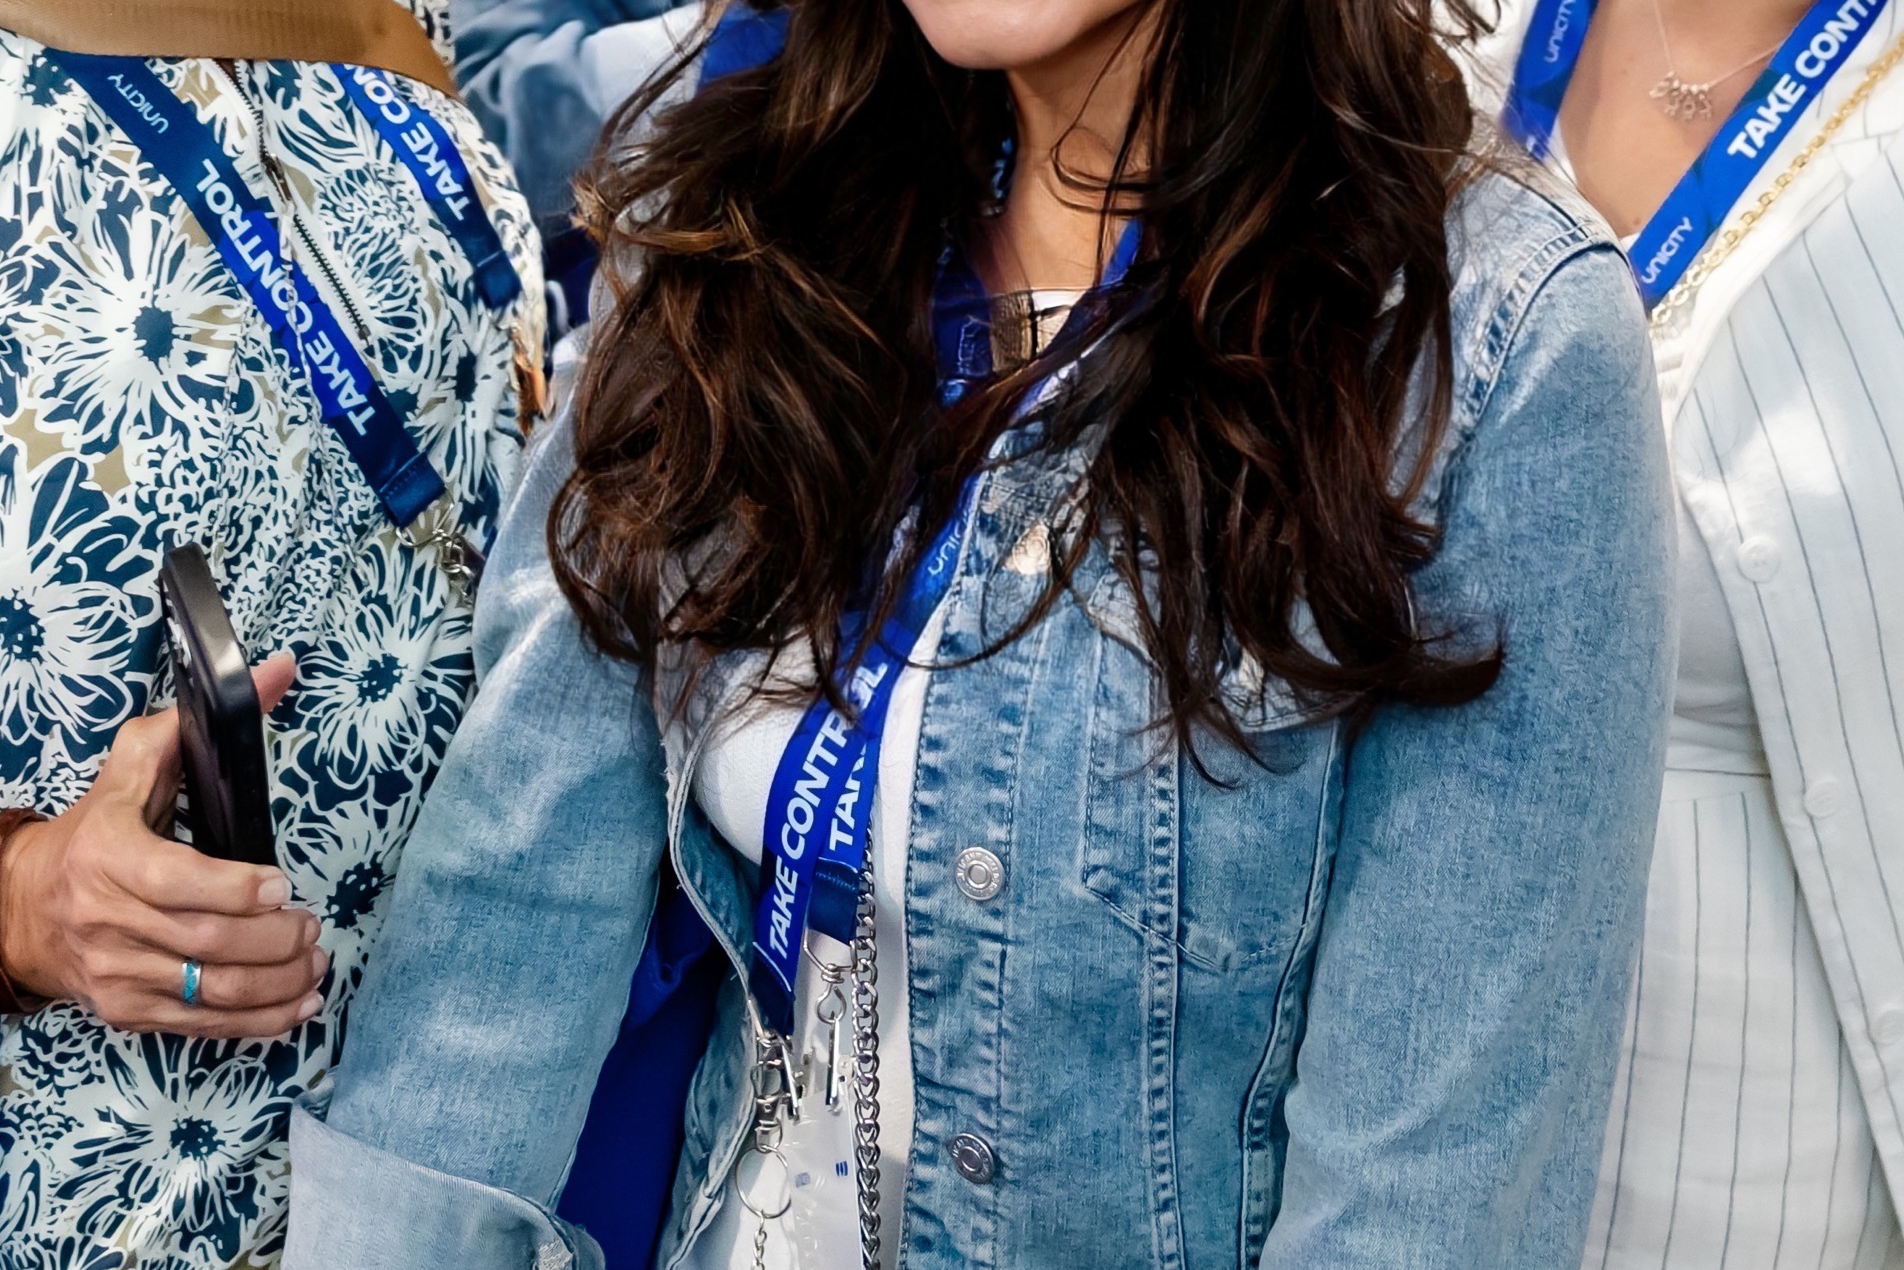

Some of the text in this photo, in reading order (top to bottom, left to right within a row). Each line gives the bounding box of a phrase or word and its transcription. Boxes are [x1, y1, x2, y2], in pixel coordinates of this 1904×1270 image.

[107, 73, 170, 135] UNICITY
[1728, 77, 1806, 161] TAKE
[400, 120, 465, 222] TAKE
[1640, 216, 1695, 284] UNICITY
[196, 157, 376, 437] TAKE CONTROL
[770, 854, 799, 960] TAKE
